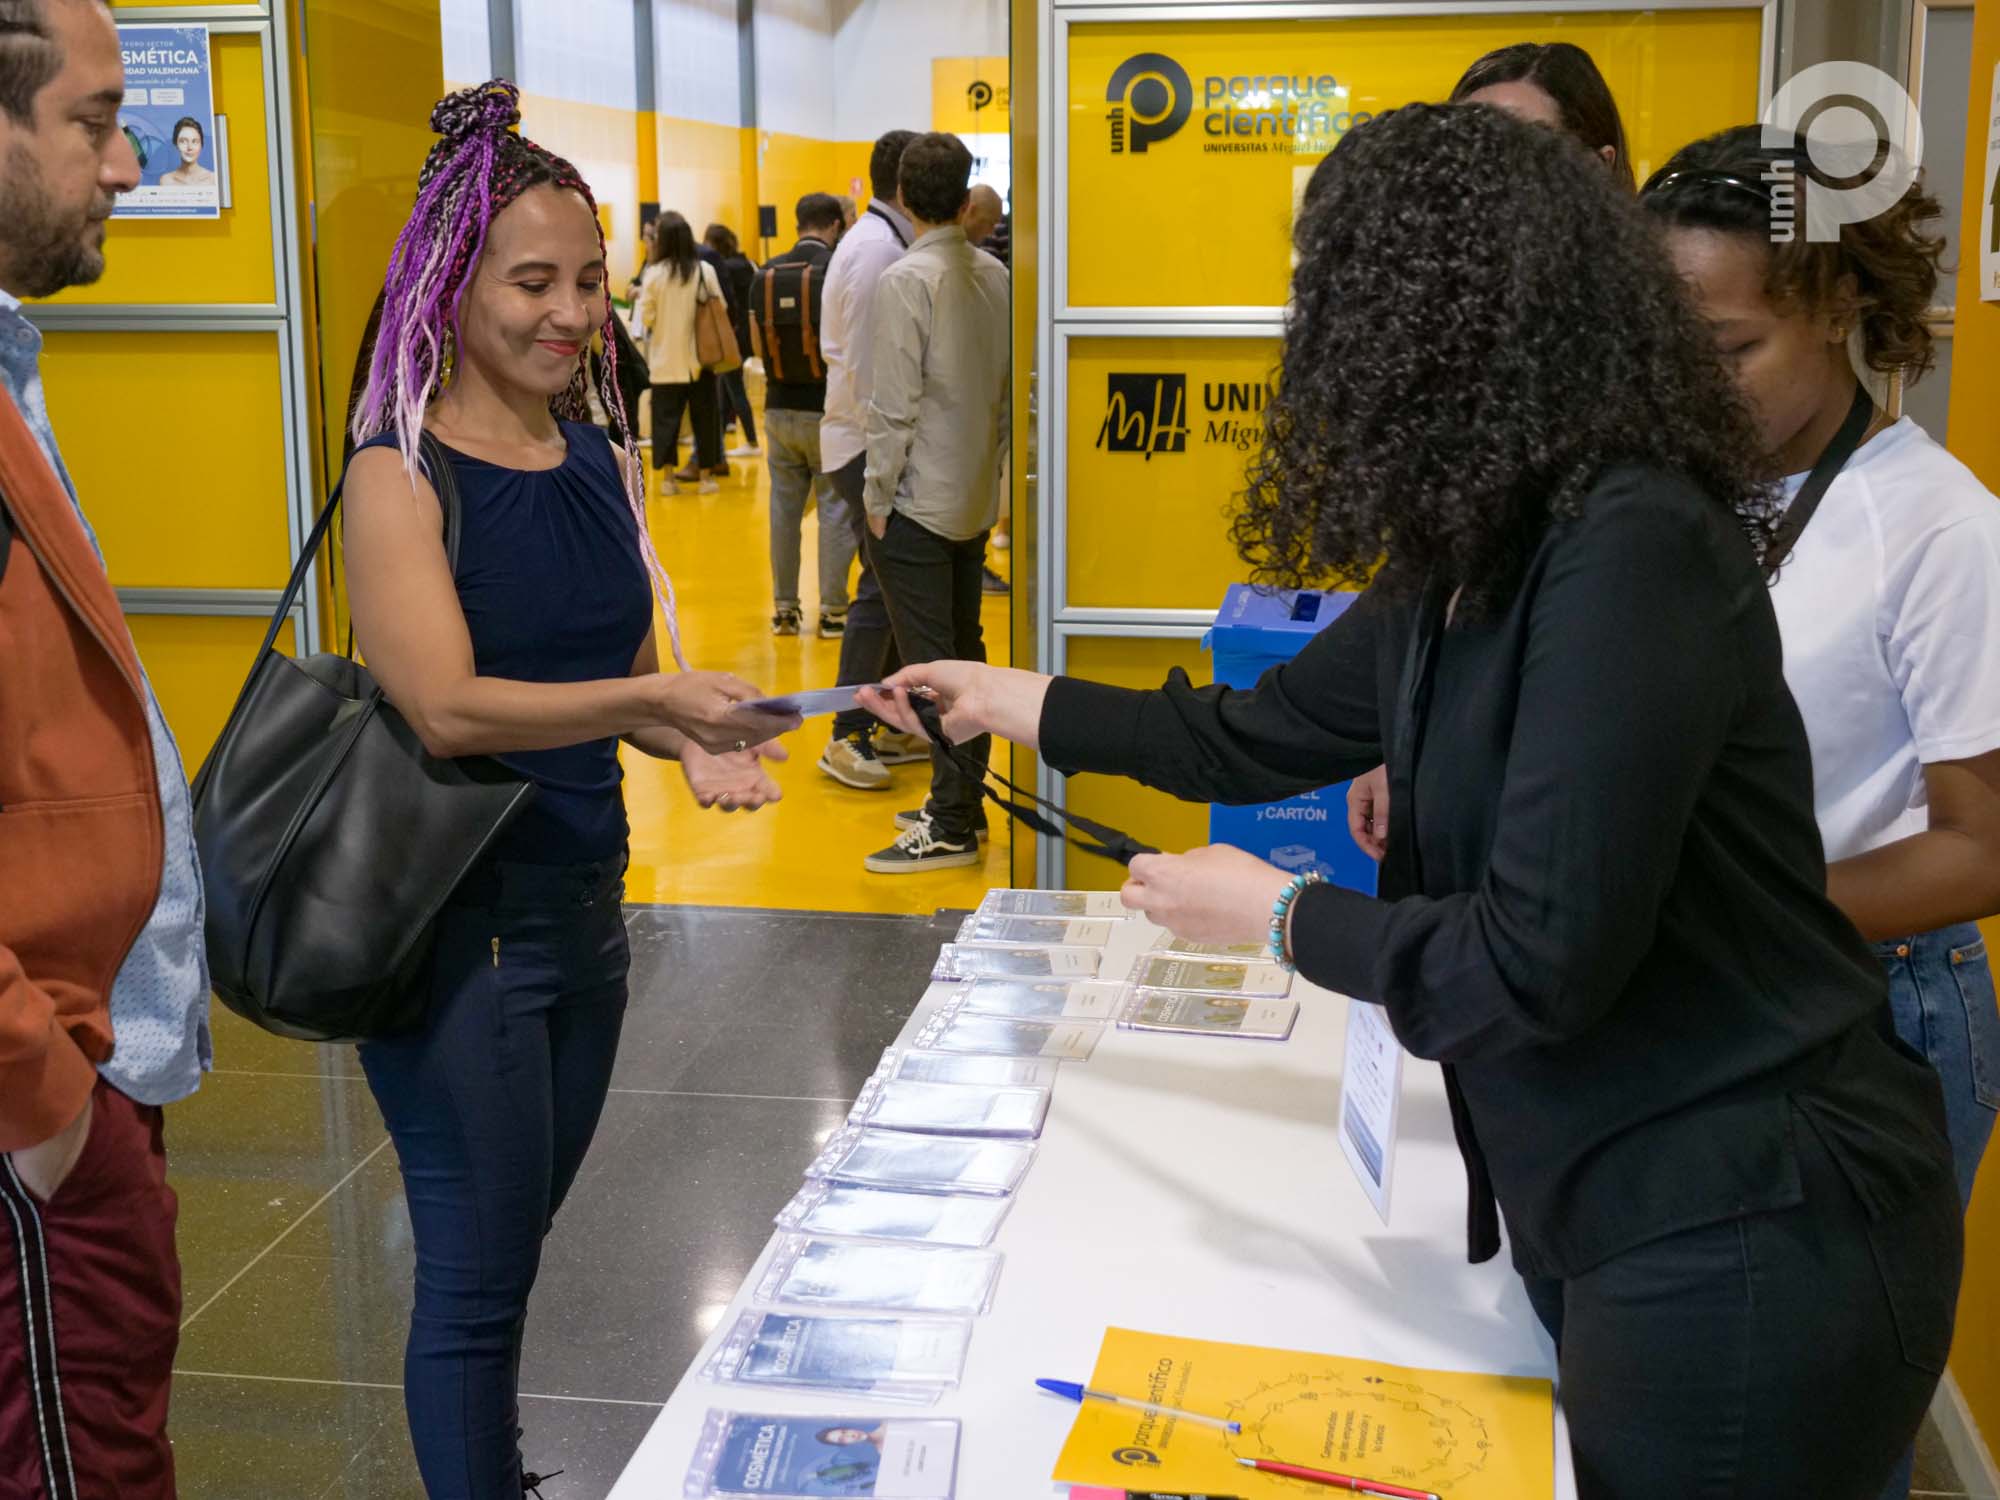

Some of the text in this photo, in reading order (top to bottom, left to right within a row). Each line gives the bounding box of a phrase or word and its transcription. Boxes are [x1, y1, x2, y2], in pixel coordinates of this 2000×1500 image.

[121, 47, 199, 65] SMÉTICA
[147, 66, 200, 75] VALENCIANA
[1204, 75, 1336, 108] parque
[1106, 107, 1125, 153] umh
[1203, 143, 1268, 153] UNIVERSITAS
[1265, 806, 1327, 821] CARTÓN
